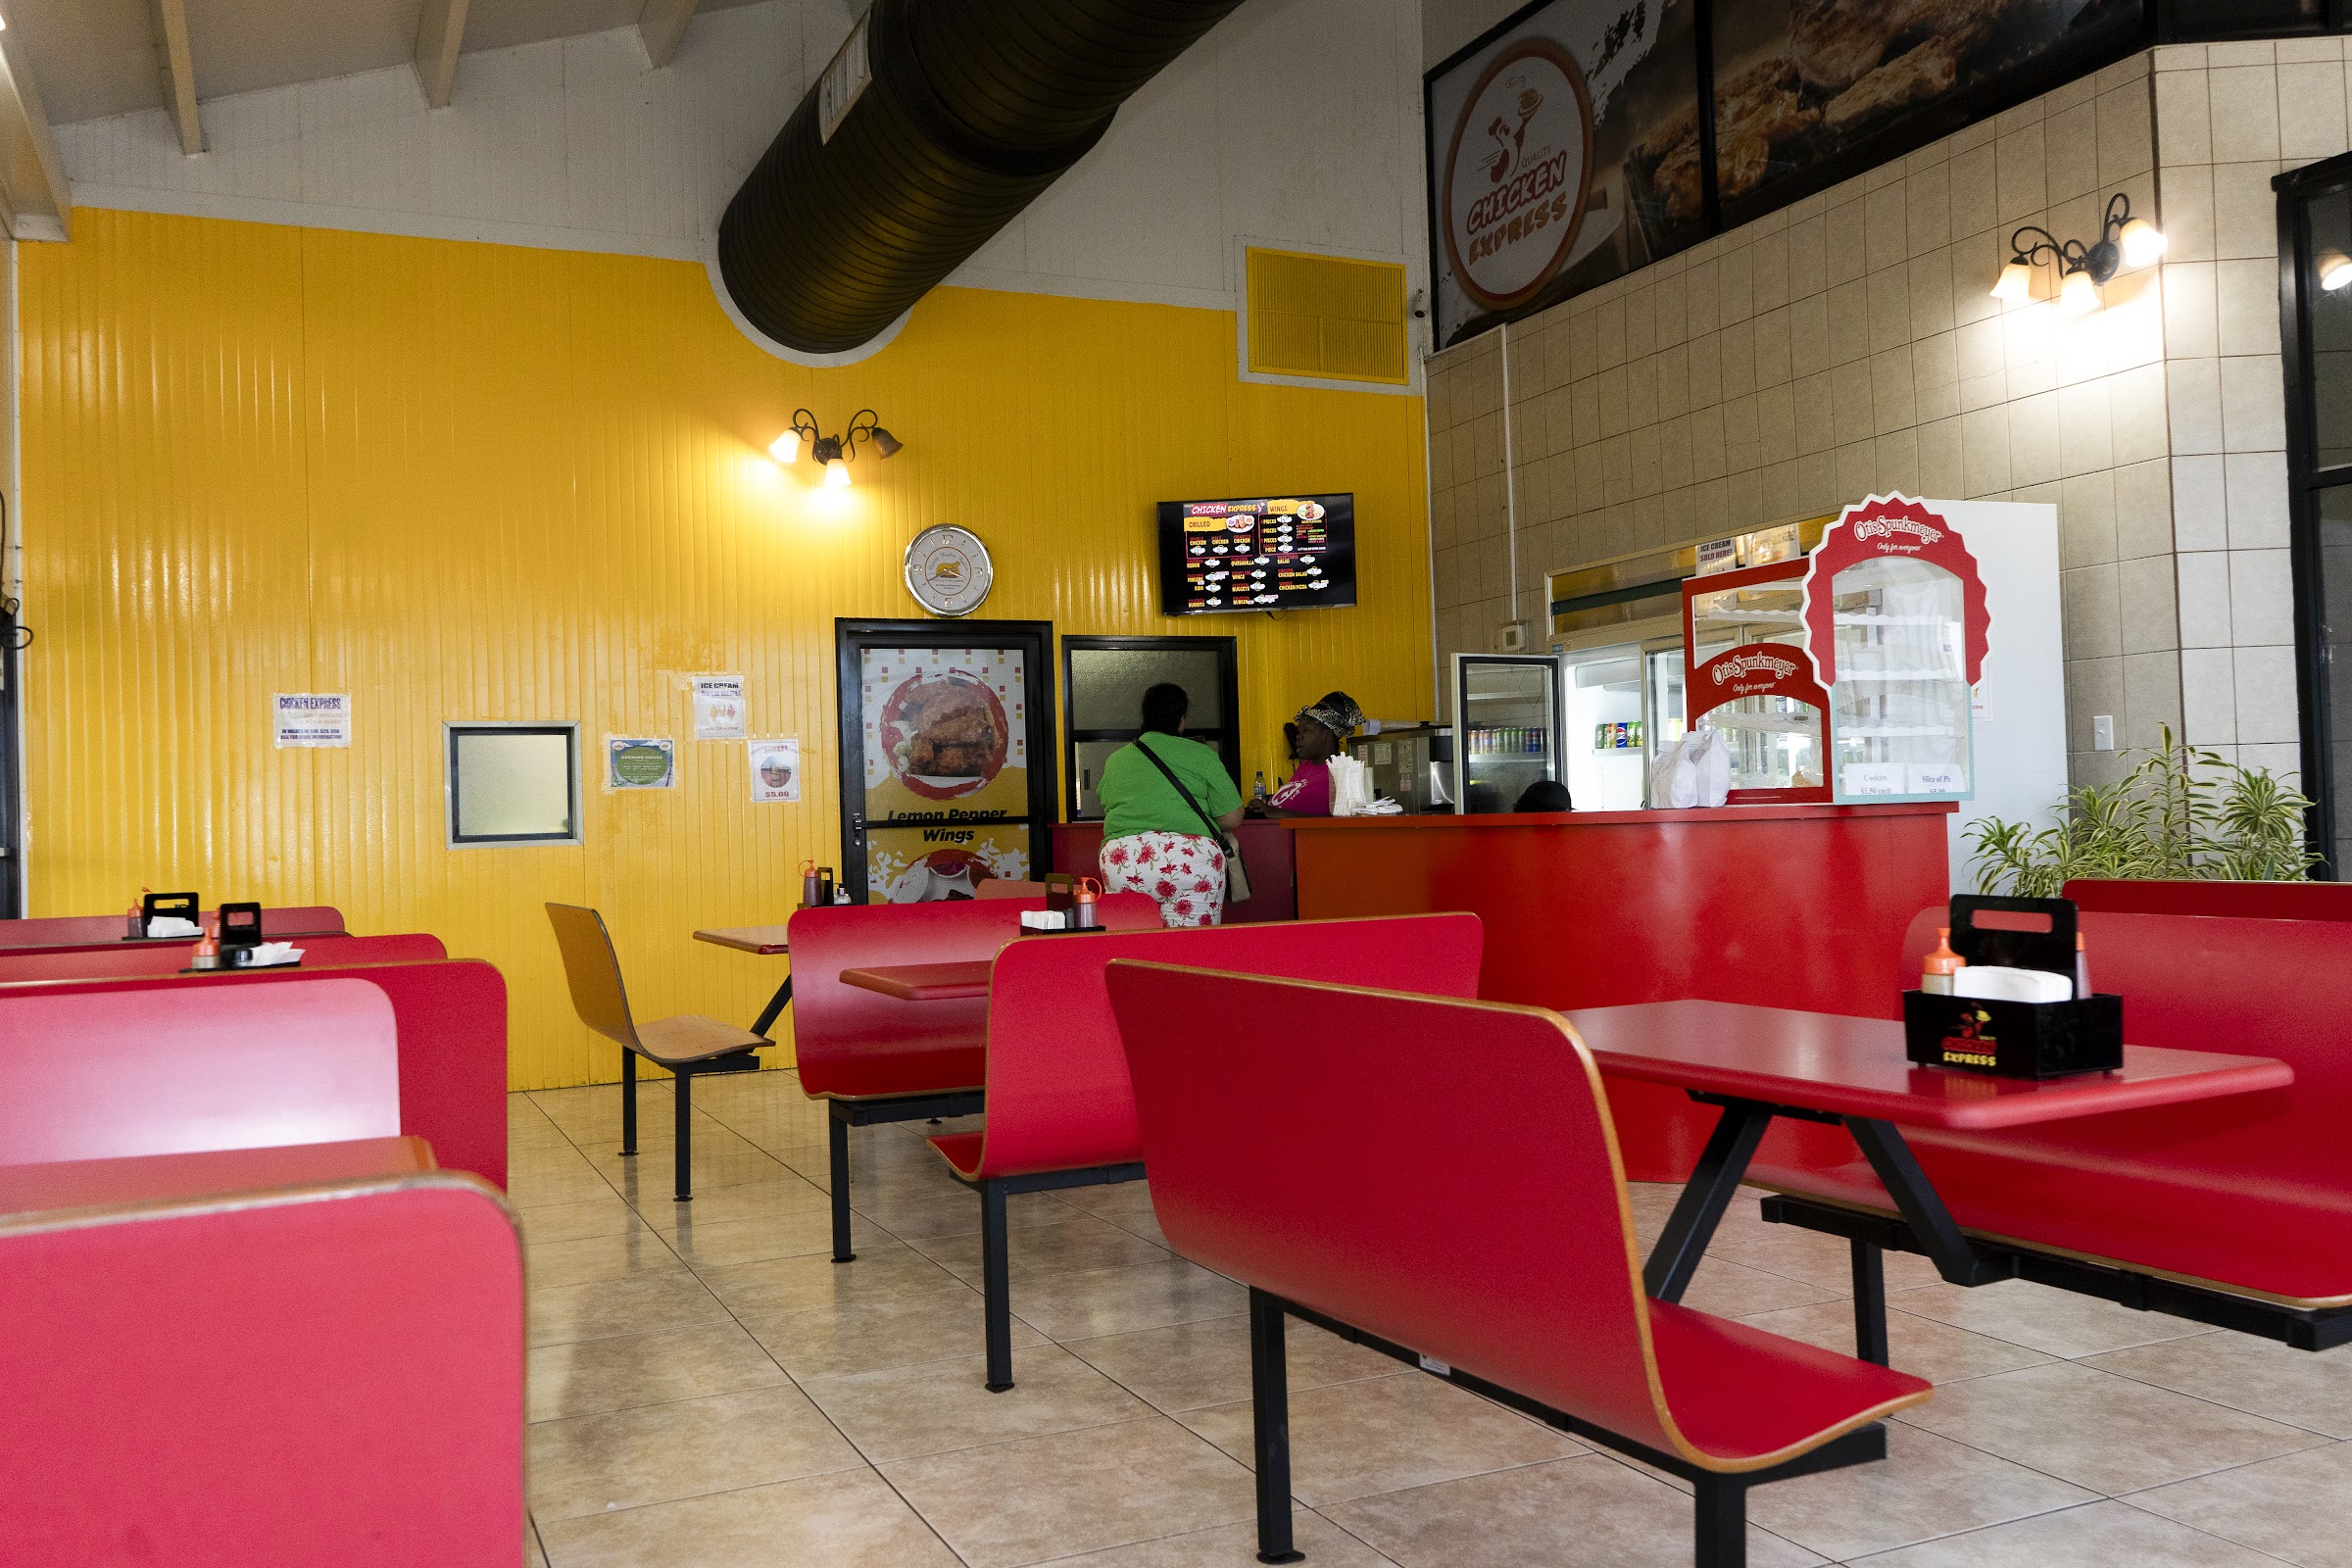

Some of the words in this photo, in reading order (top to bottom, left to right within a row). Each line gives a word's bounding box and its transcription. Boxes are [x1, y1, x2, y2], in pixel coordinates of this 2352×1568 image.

[1521, 144, 1552, 169] QUALITY
[1466, 150, 1567, 235] CHICKEN
[1469, 191, 1567, 267] EXPRESS
[1192, 505, 1227, 514] CHICKEN
[1227, 504, 1256, 513] EXPRESS
[1854, 519, 1878, 541] Otis
[1877, 515, 1941, 545] Spunkmeyer
[943, 534, 954, 545] 12
[1700, 543, 1710, 553] ICE
[1711, 540, 1731, 550] CREAM
[1699, 553, 1715, 562] SOLD
[1716, 549, 1733, 559] HERE!
[945, 597, 954, 608] 6
[1712, 662, 1734, 685] Otis
[1733, 651, 1796, 679] Spunkmeyer
[280, 697, 309, 710] CHICKEN
[310, 697, 341, 710] EXPRESS
[888, 809, 944, 821] Lemon
[923, 828, 974, 843] Wings
[1943, 1052, 1996, 1066] EXPRESS
